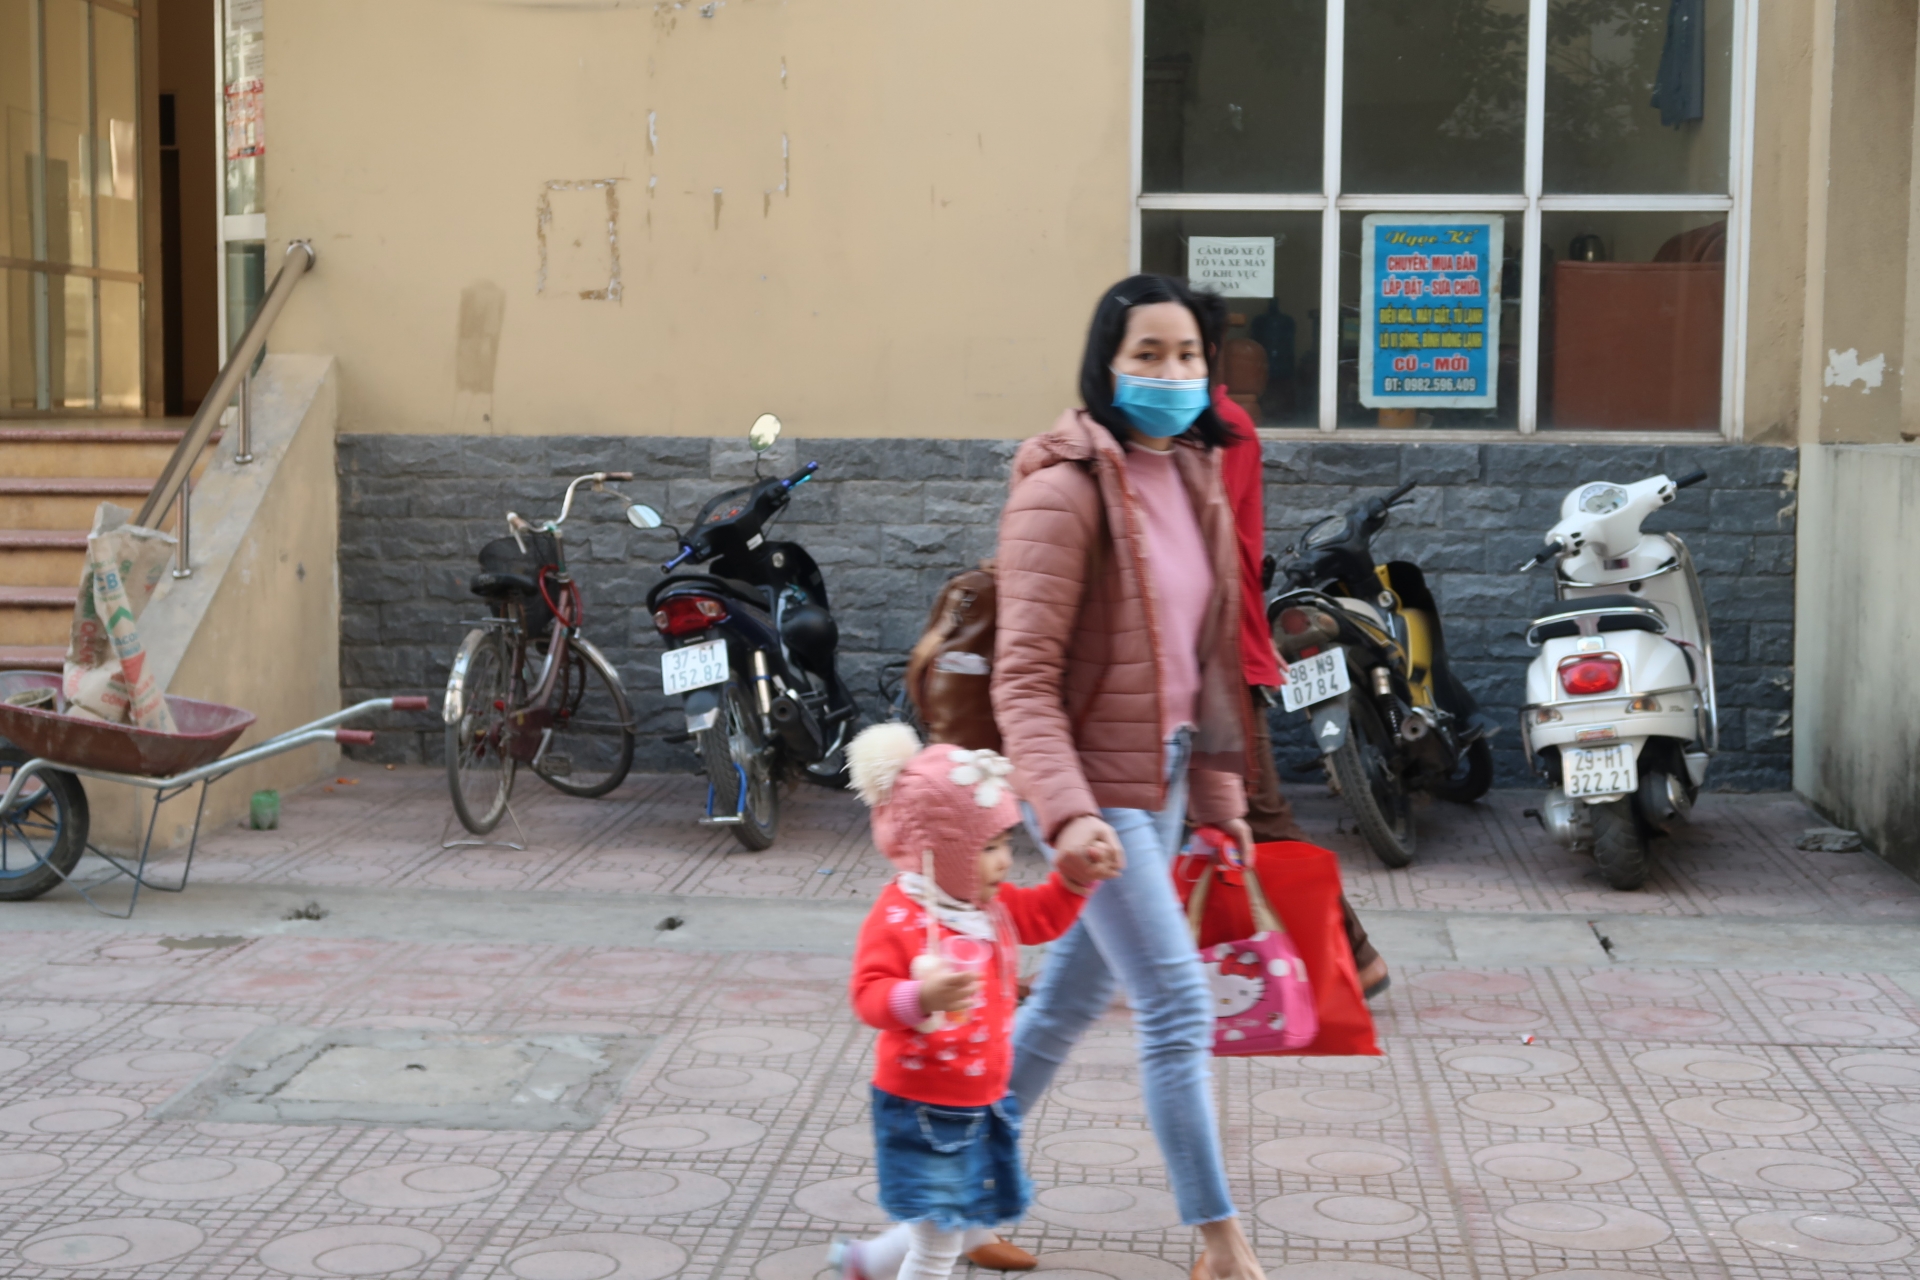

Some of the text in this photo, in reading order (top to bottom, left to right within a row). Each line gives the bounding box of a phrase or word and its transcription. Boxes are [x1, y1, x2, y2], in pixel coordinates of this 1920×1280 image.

[1385, 230, 1438, 247] Ngọc
[1241, 247, 1254, 255] XE
[1256, 245, 1265, 255] Ô
[1431, 255, 1453, 271] MUA
[1434, 353, 1469, 372] MỚI
[1384, 377, 1476, 392] ĐT: 0982.596.409
[1293, 674, 1339, 704] 0784
[1575, 746, 1624, 771] 29-H1
[1571, 769, 1632, 794] 322.21
